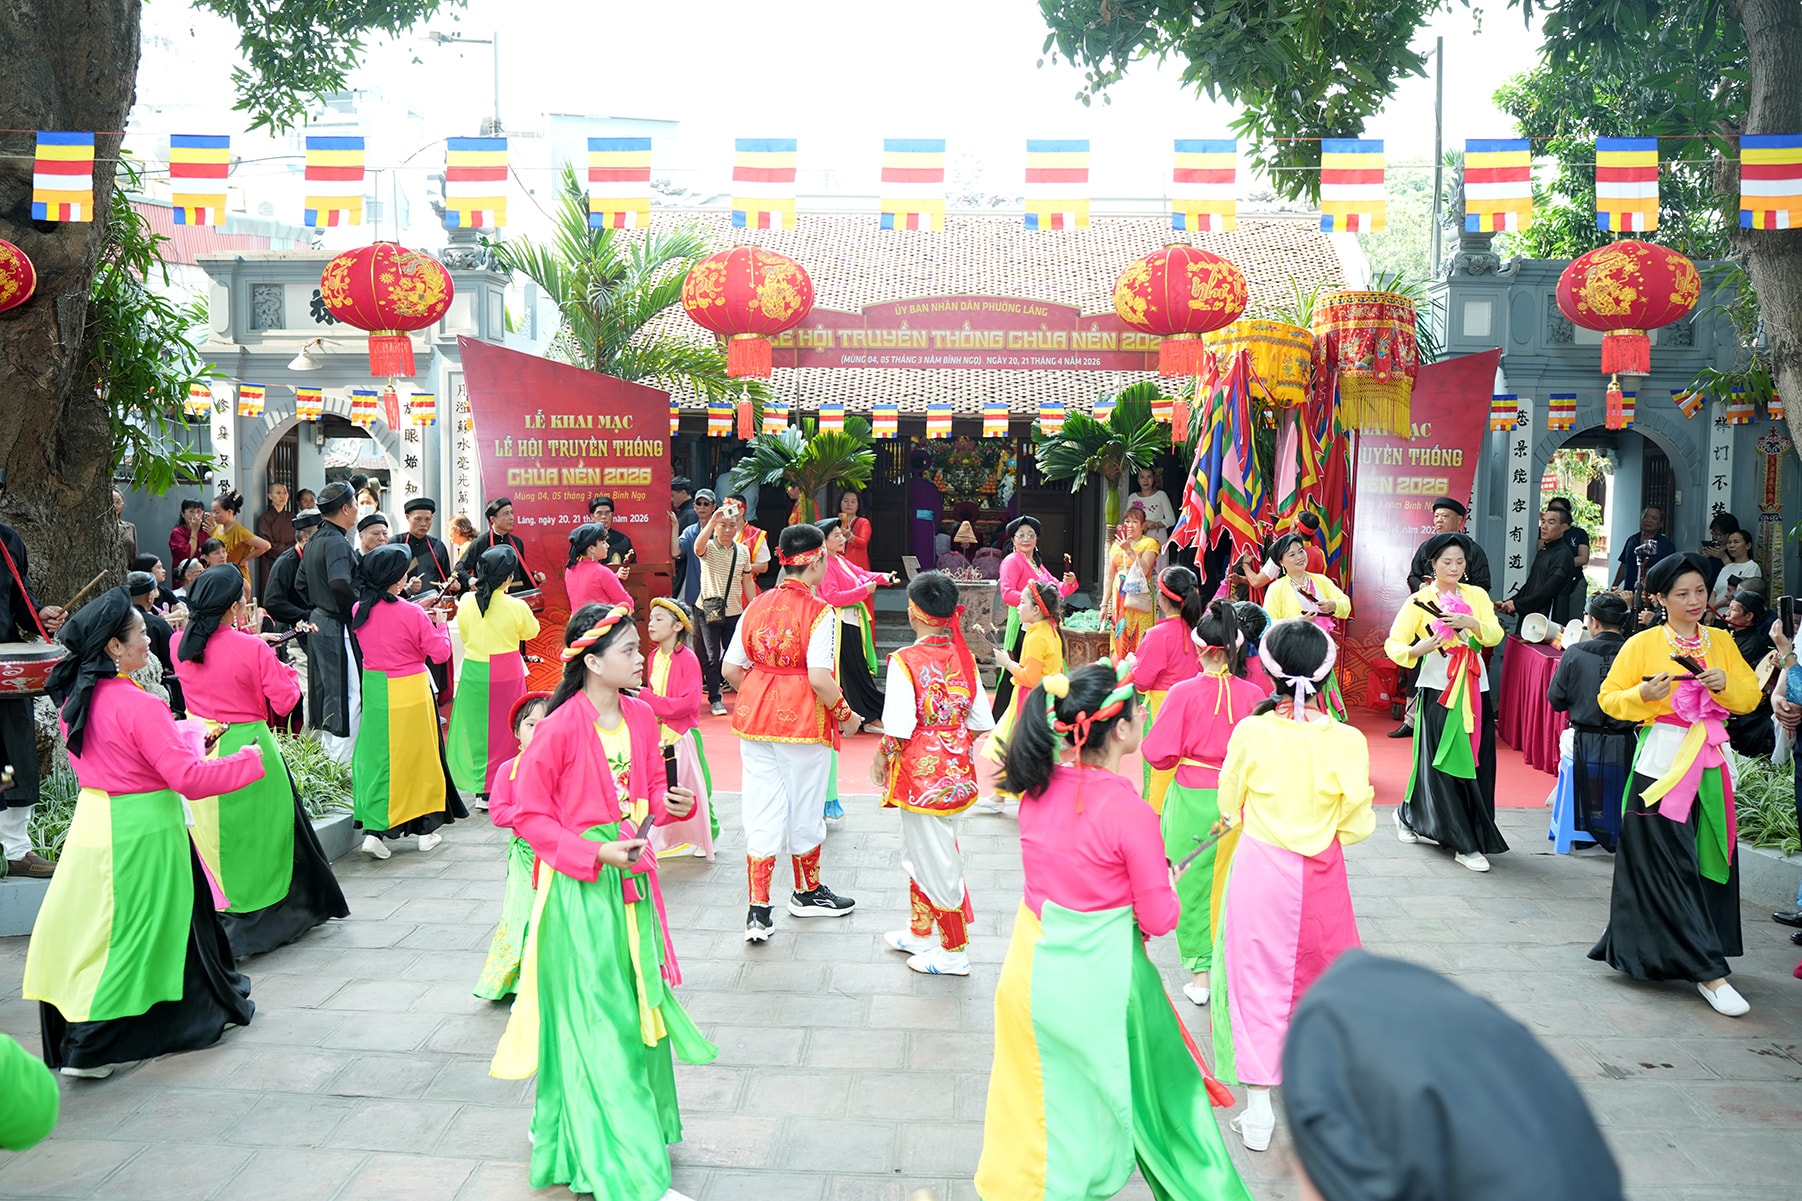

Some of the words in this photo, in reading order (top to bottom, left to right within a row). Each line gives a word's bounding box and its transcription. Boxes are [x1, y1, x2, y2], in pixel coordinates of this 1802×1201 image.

[910, 304, 929, 313] BAN
[931, 300, 958, 312] NHÂN
[961, 300, 980, 311] DÂN
[1023, 304, 1048, 317] LÁNG
[799, 323, 834, 351] HỘI
[838, 321, 927, 348] TRUYỀN
[931, 321, 1004, 348] THỐNG
[1008, 323, 1067, 349] CHÙA
[1071, 323, 1116, 349] NỀN
[1121, 332, 1160, 350] 202
[867, 356, 879, 365] 04,
[881, 355, 889, 364] 05
[890, 354, 917, 364] THÁNG
[918, 356, 922, 364] 3
[986, 355, 1007, 365] NGÀY
[1009, 356, 1020, 366] 20,
[1021, 356, 1029, 365] 21
[1030, 355, 1056, 365] THÁNG
[1057, 357, 1062, 365] 4
[1083, 357, 1101, 366] 2026
[524, 409, 546, 429] LỄ
[550, 414, 593, 429] KHAI
[597, 414, 634, 434] MẠC
[1409, 422, 1432, 442] ẠC
[517, 437, 543, 460] HỘI
[547, 435, 608, 458] TRUYỀN
[613, 435, 663, 457] THỐNG
[1408, 443, 1464, 467] THỐNG
[507, 460, 559, 486] CHÙA
[562, 459, 601, 486] NỀN
[603, 467, 652, 486] 2026
[1397, 477, 1449, 495] 2026
[552, 491, 561, 500] 05
[564, 491, 585, 502] tháng
[587, 491, 592, 500] 3
[573, 514, 580, 523] 21
[630, 514, 649, 523] 2026
[1421, 525, 1438, 534] 202
